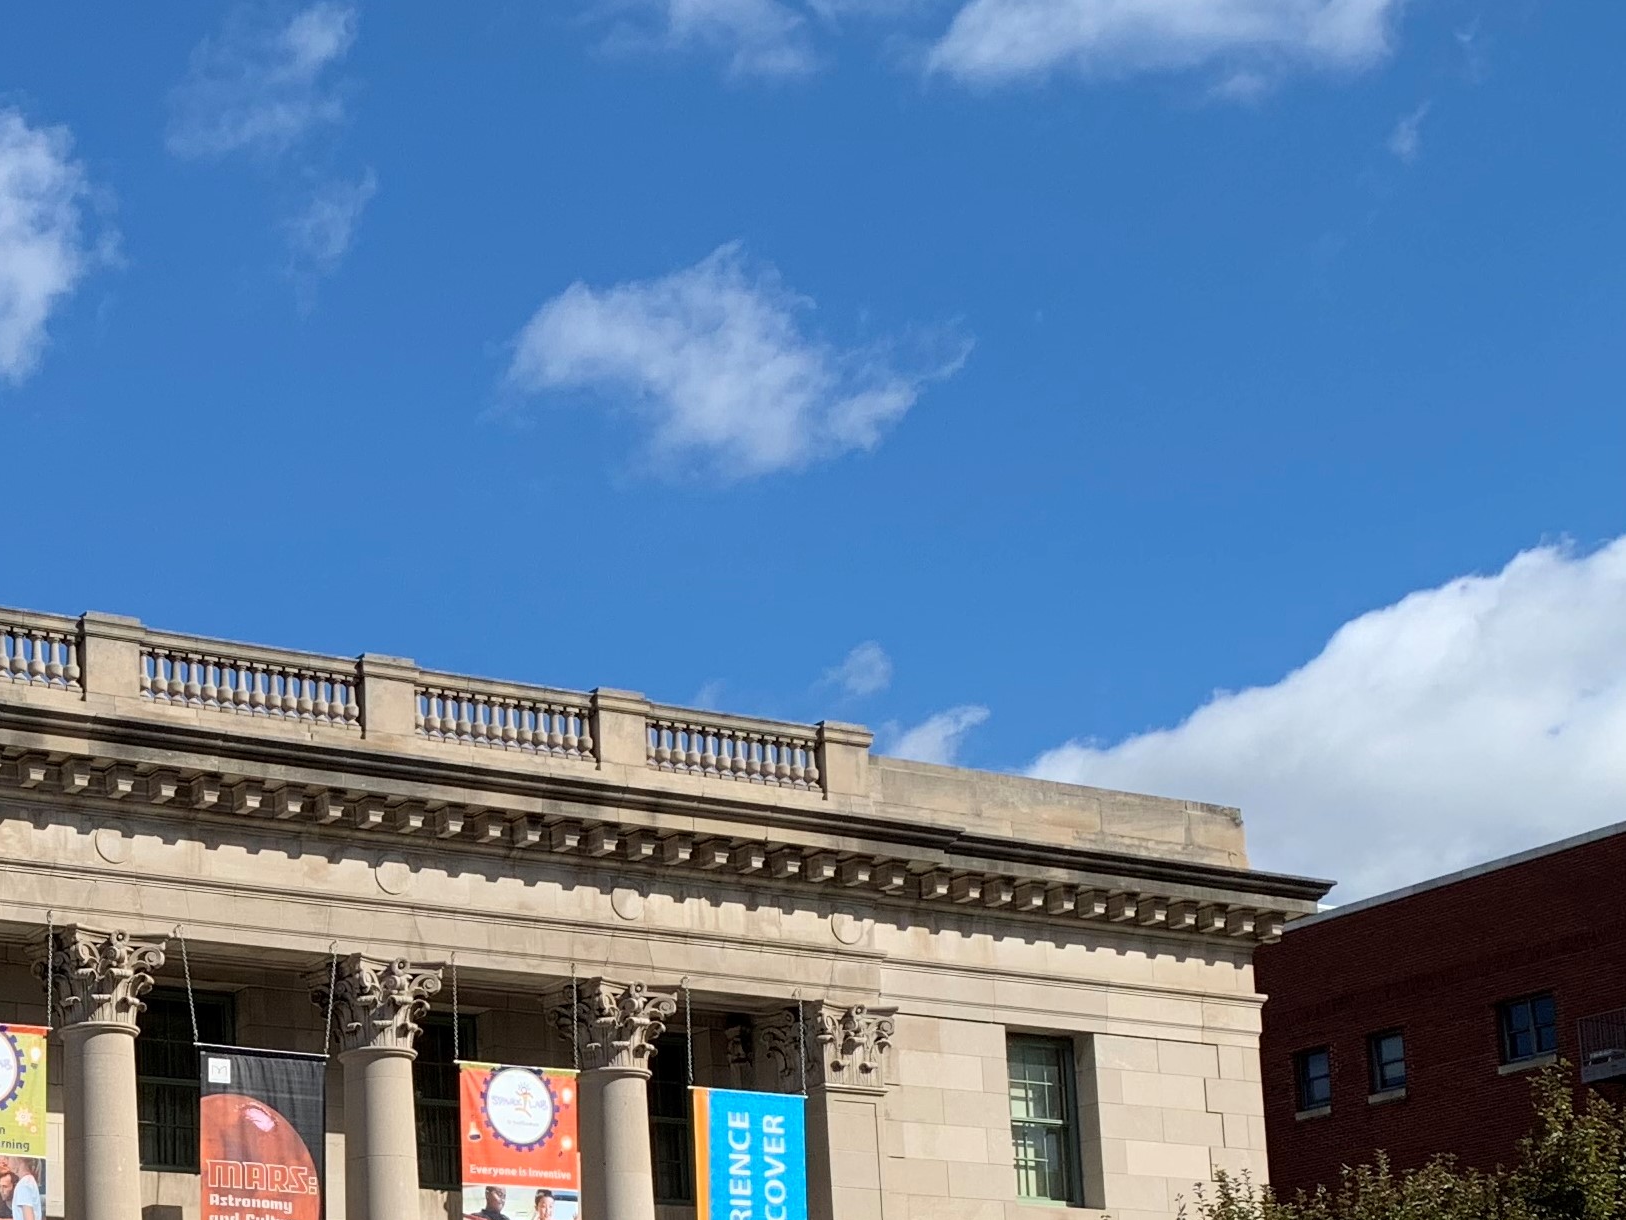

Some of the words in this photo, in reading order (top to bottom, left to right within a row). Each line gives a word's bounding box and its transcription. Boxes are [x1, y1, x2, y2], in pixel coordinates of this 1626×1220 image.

[206, 1159, 318, 1196] MARS:
[469, 1164, 517, 1178] Everyone
[209, 1193, 293, 1214] Astronomy
